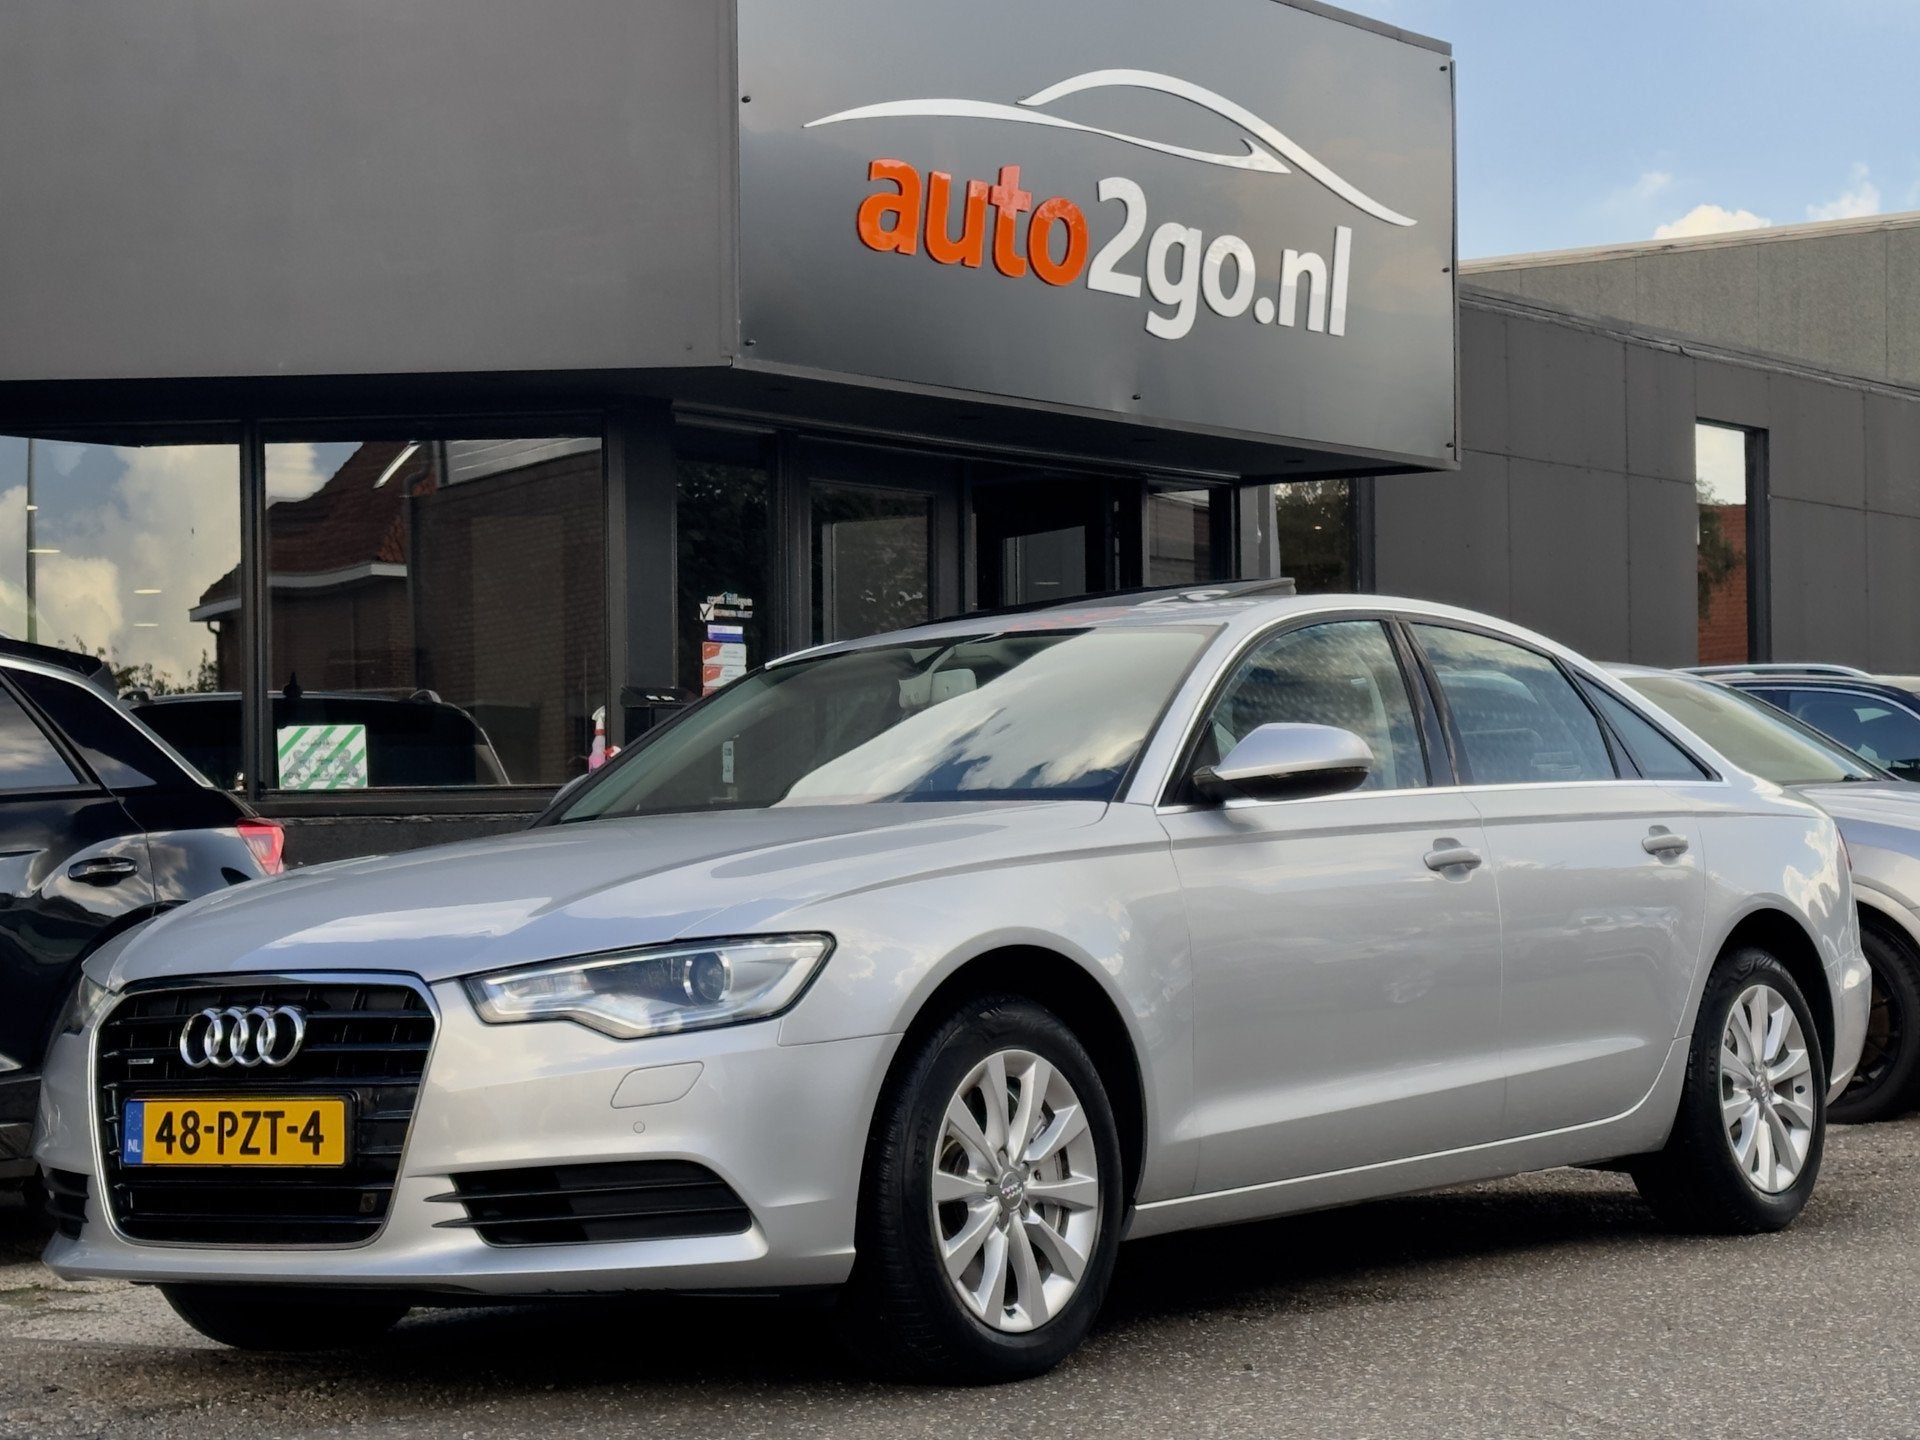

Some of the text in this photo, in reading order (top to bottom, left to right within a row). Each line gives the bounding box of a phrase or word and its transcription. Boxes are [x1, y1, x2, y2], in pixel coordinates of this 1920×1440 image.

[857, 158, 1352, 340] auto2go.nl
[128, 1140, 141, 1152] NL
[155, 1110, 325, 1155] 48-PZT-4
